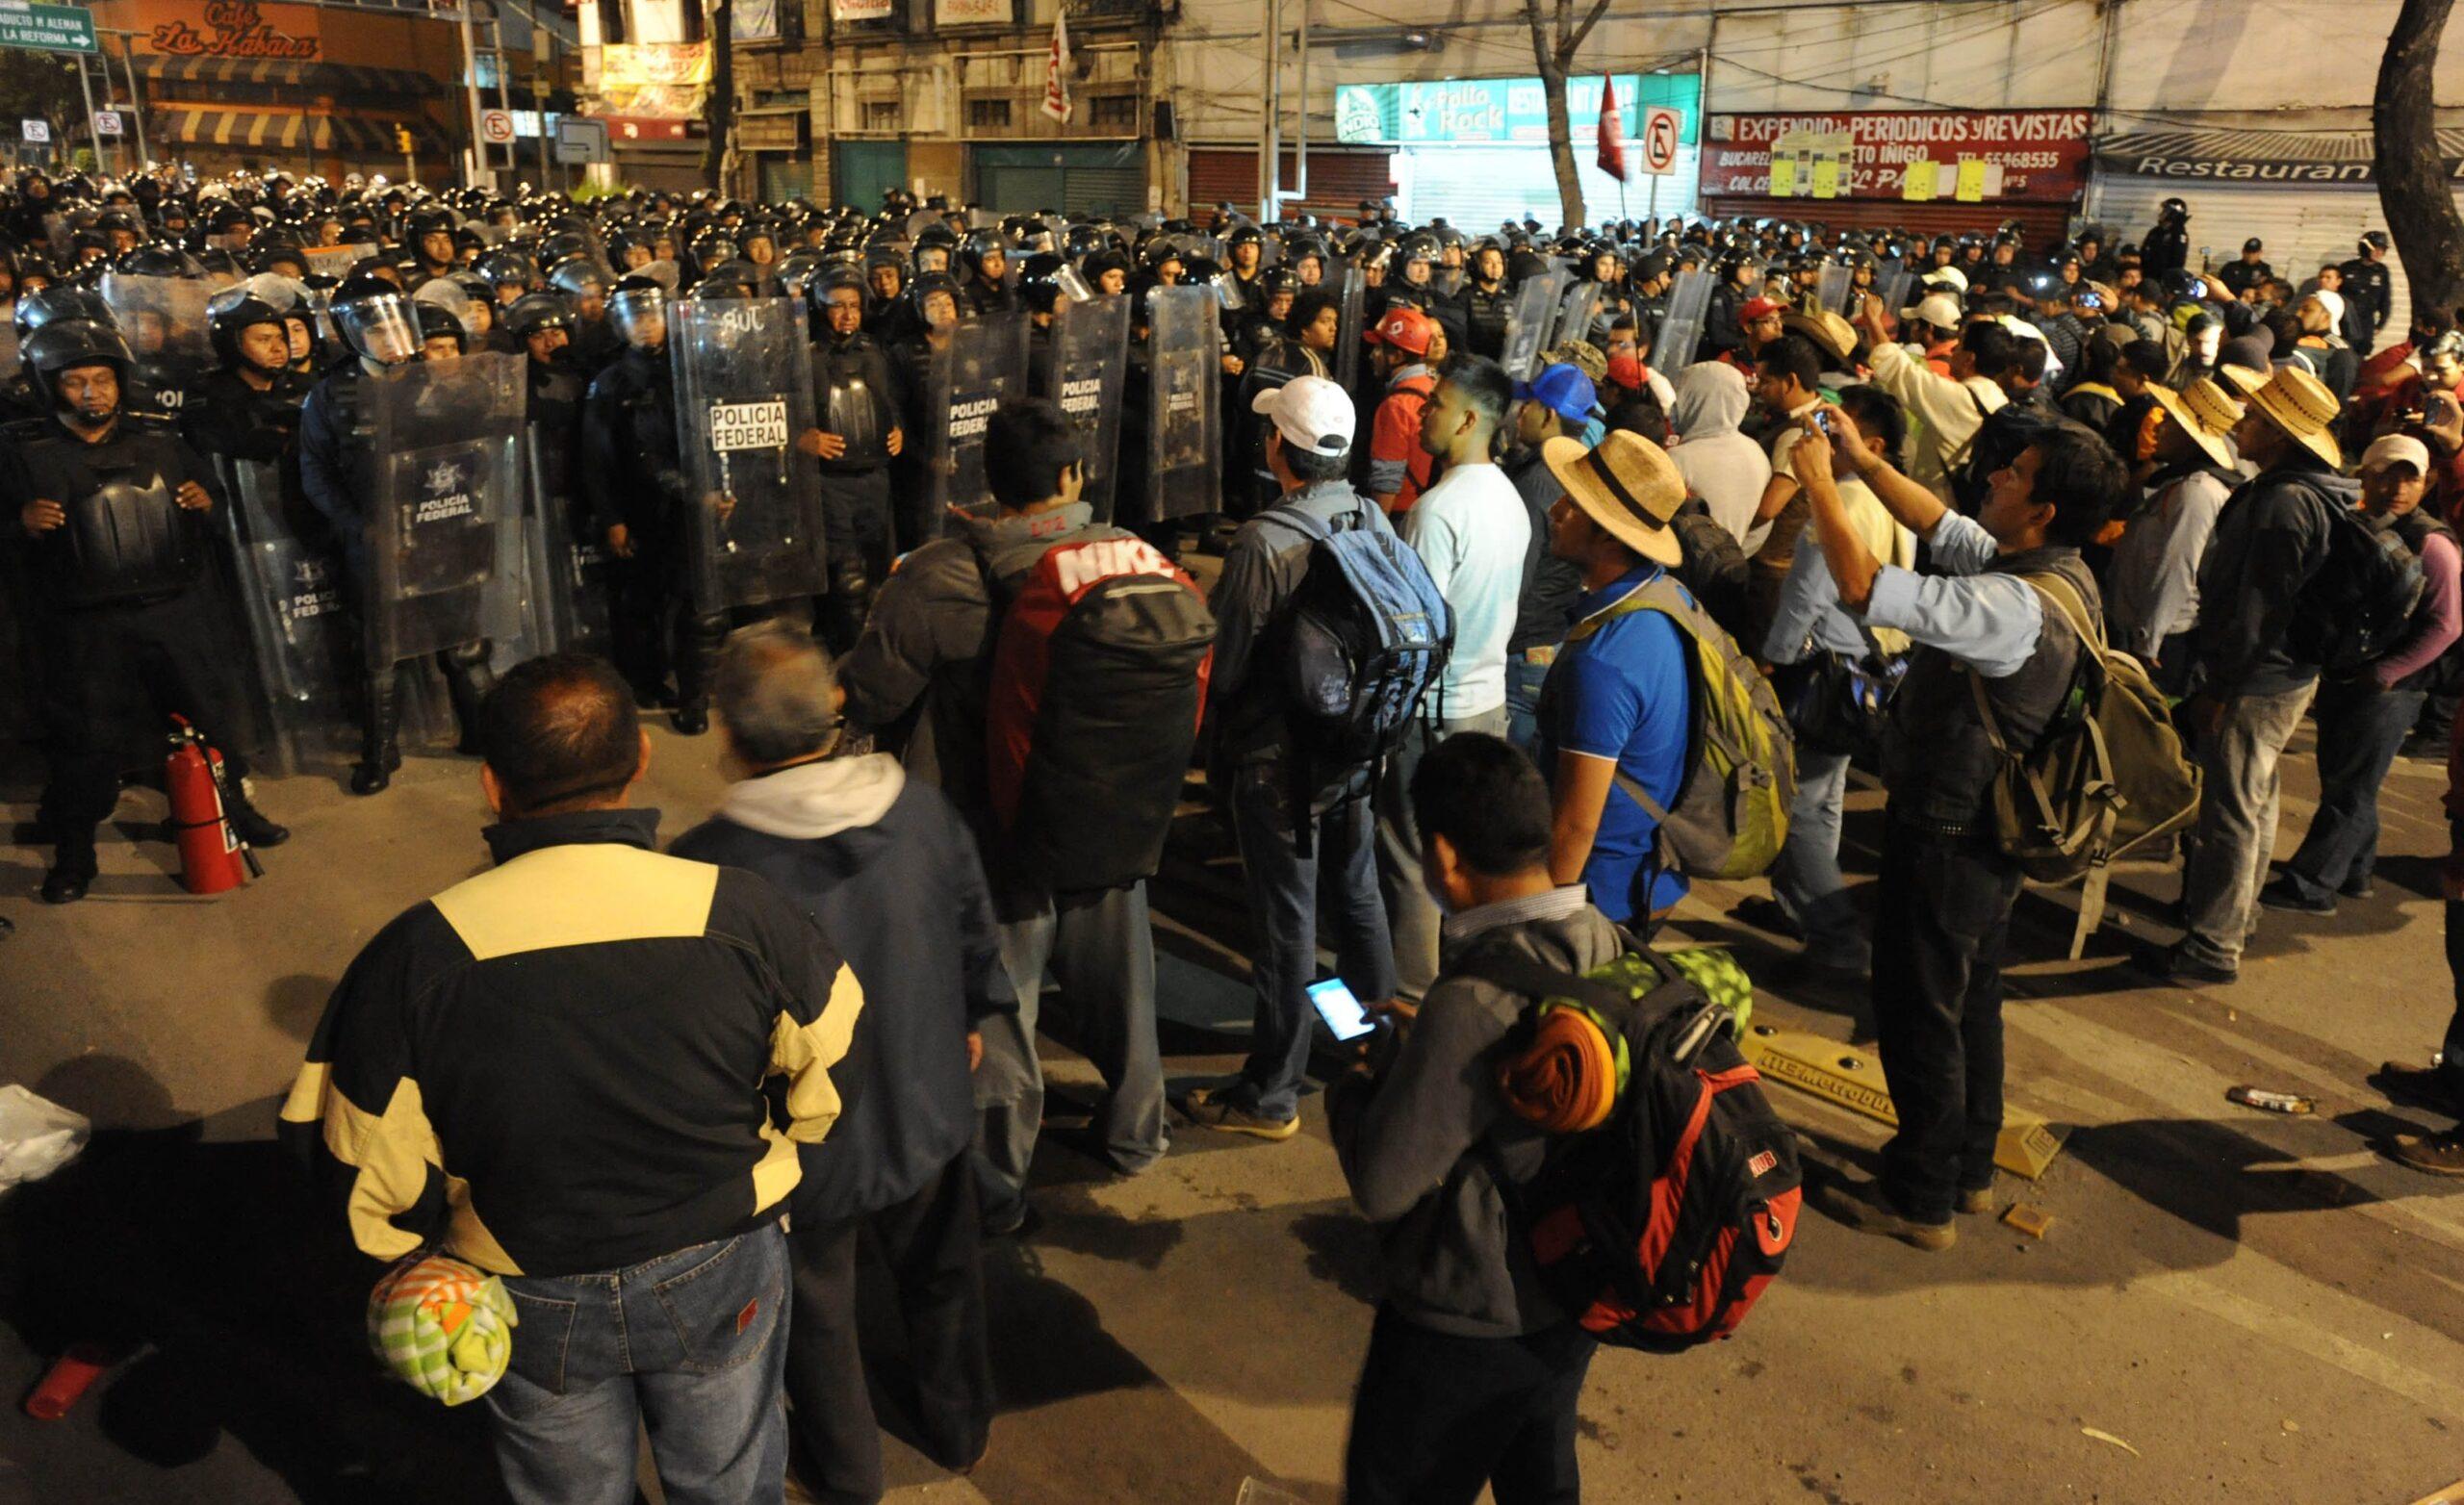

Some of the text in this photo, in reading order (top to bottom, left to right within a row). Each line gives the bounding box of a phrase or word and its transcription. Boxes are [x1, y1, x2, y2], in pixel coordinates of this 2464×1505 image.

[204, 0, 262, 27] Café
[3, 29, 69, 45] LA REFORMA
[151, 21, 321, 58] La Habana
[1440, 103, 1503, 133] Rock
[1850, 115, 1968, 142] PERIODICOS
[1983, 114, 2088, 141] REVISTAS
[1719, 151, 1771, 166] BUCAREL
[2137, 156, 2371, 180] Restauran
[1062, 394, 1100, 413] FEDERAL
[713, 405, 784, 426] POLICIA
[949, 416, 989, 437] FEDER
[714, 425, 785, 447] FEDERAL
[416, 504, 473, 523] FEDERAL
[1055, 539, 1175, 596] NIKE
